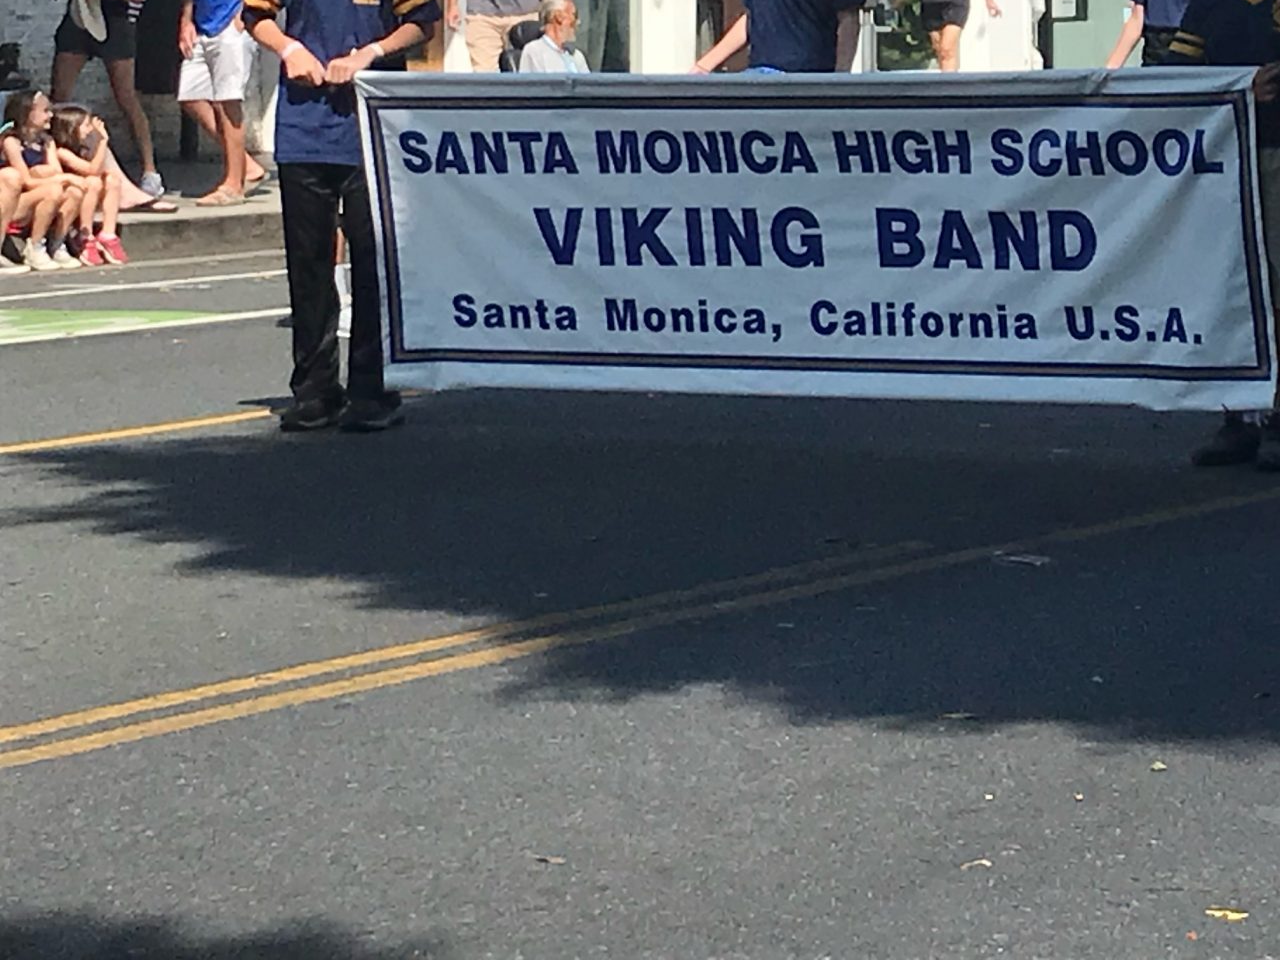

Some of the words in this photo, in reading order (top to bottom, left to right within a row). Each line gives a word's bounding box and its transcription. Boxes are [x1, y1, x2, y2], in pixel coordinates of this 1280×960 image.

[398, 129, 579, 176] SANTA
[594, 129, 813, 176] MONICA
[831, 129, 972, 176] HIGH
[989, 127, 1224, 177] SCHOOL
[532, 206, 825, 270] VIKING
[875, 207, 1098, 272] BAND
[452, 293, 578, 332] Santa
[604, 297, 783, 343] Monica,
[809, 299, 1039, 341] California
[1063, 304, 1204, 345] U.S.A.
